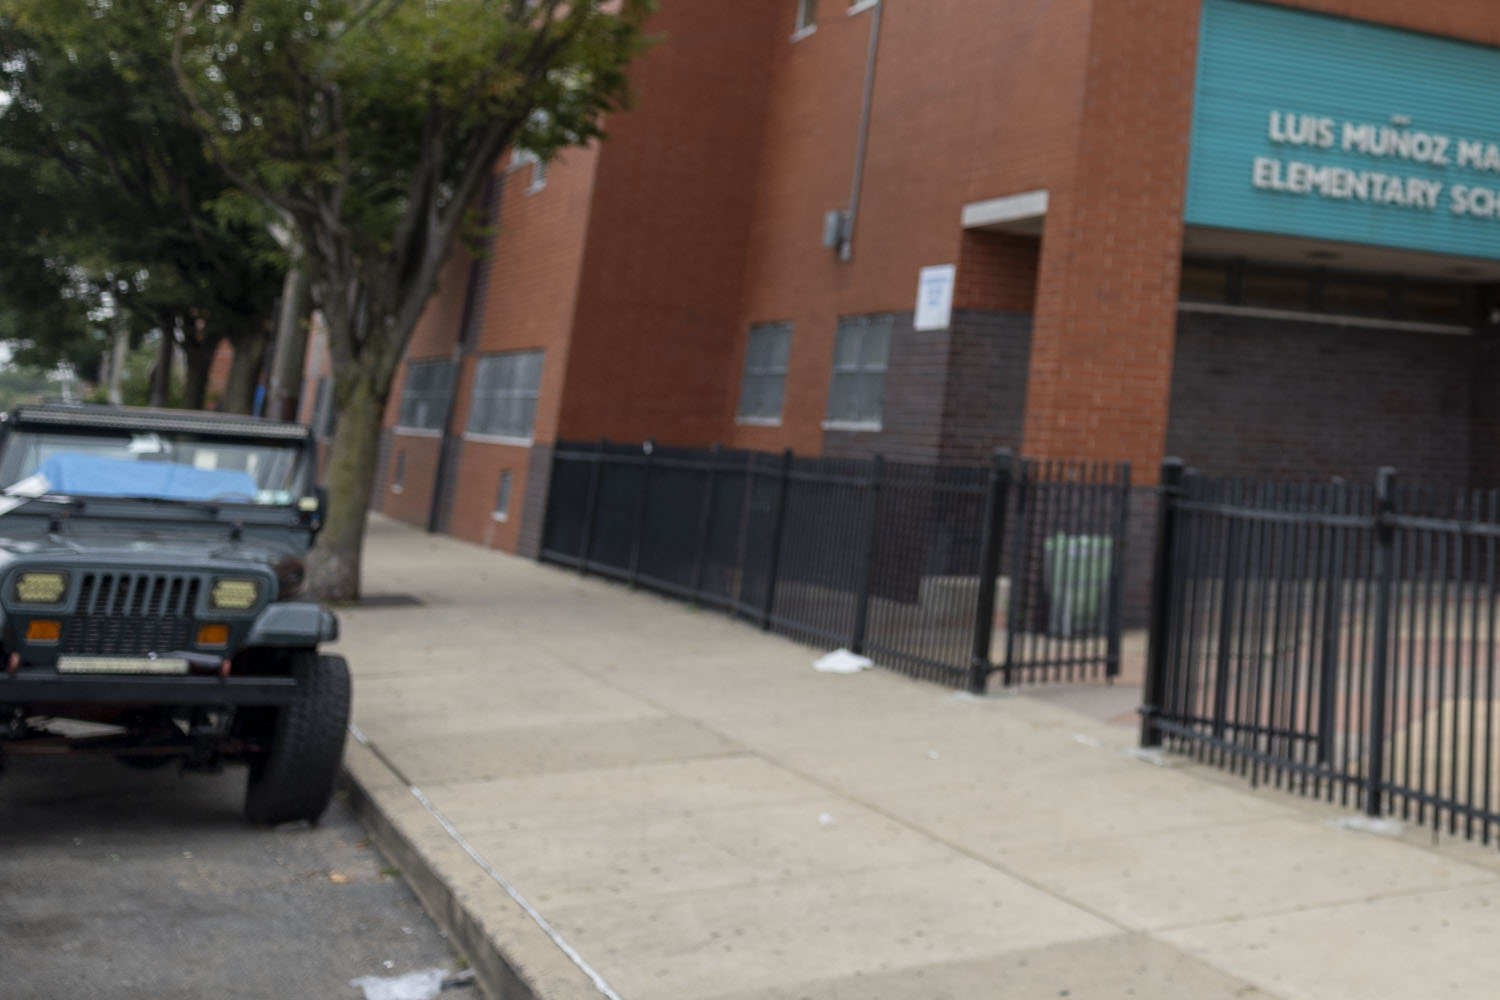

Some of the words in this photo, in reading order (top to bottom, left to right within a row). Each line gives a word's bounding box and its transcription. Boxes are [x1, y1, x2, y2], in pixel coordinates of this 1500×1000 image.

[1268, 110, 1335, 148] LUIS
[1341, 114, 1450, 166] MUÑOZ
[1253, 158, 1442, 209] ELEMENTARY
